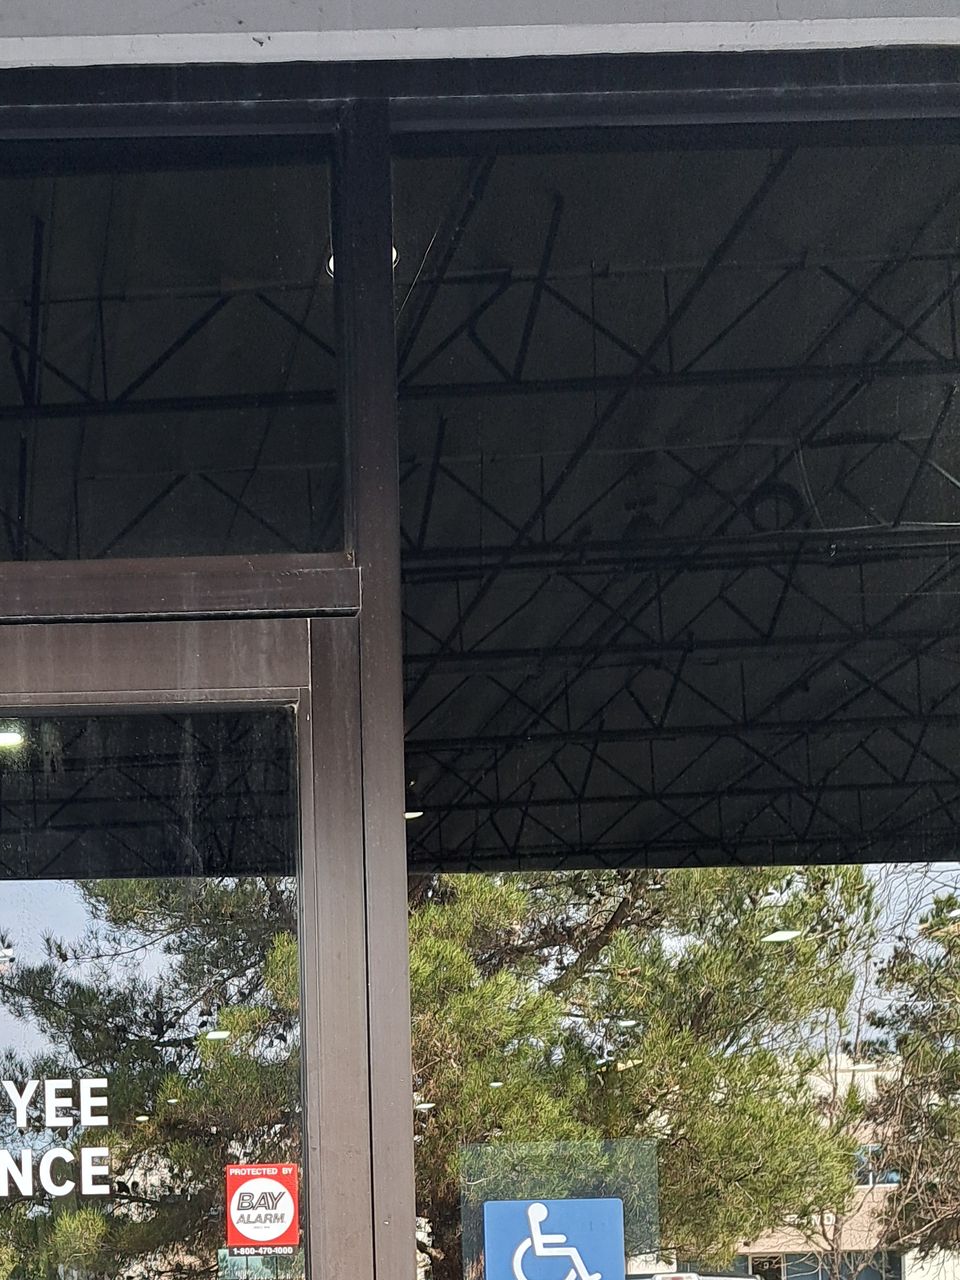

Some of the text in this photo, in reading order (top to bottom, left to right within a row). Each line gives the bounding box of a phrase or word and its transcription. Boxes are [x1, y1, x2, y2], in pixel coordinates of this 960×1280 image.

[282, 1167, 293, 1175] BY
[236, 1192, 286, 1211] BAY
[236, 1213, 285, 1224] ALARM
[232, 1246, 293, 1255] 1-800-470-1000
